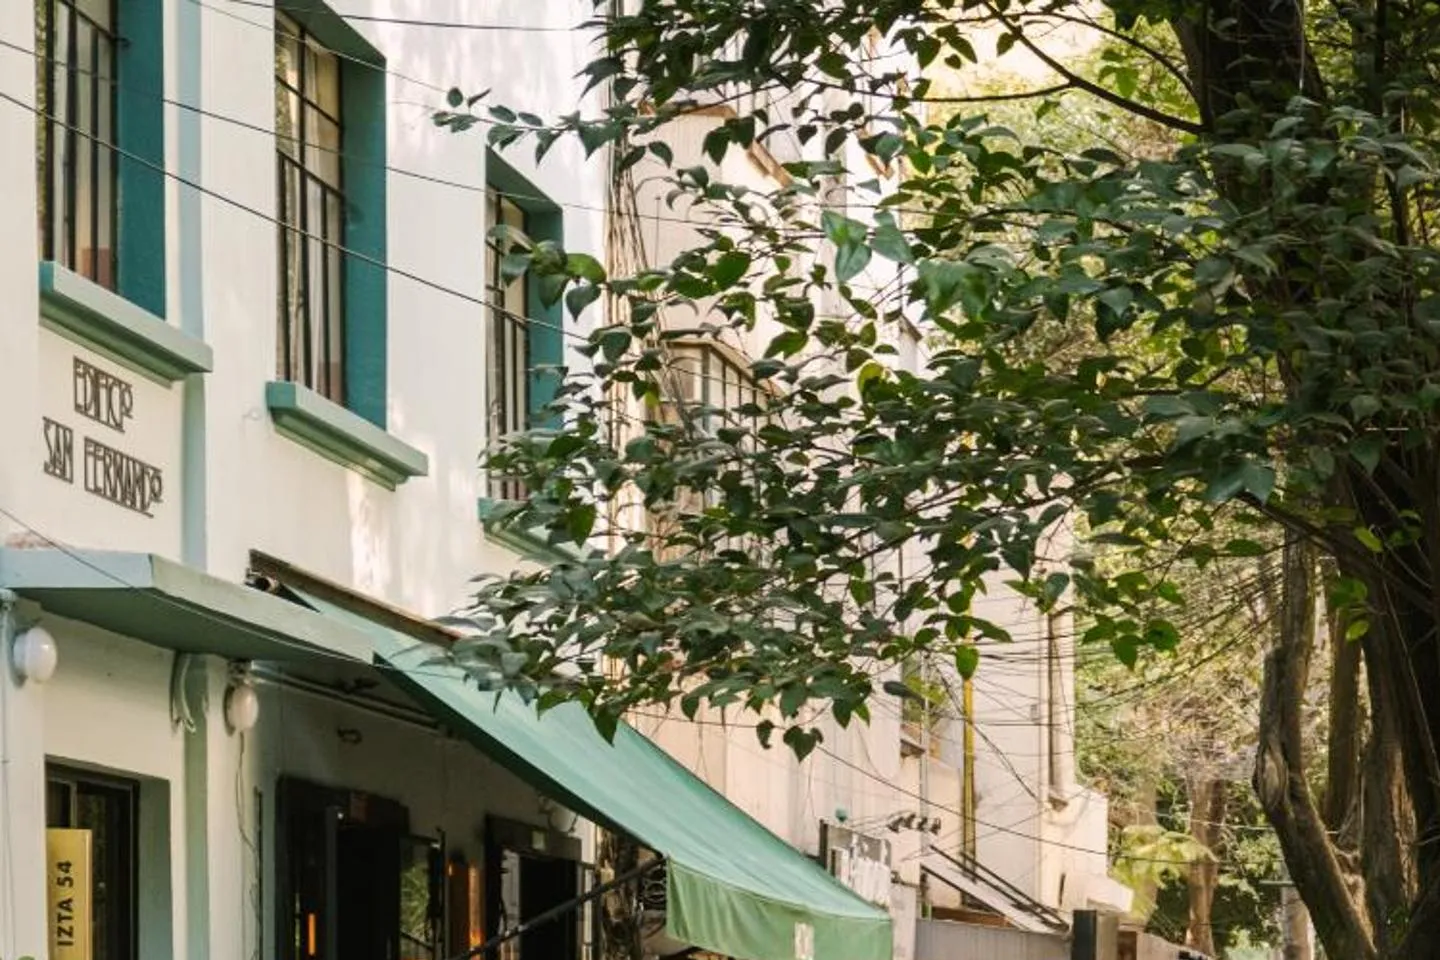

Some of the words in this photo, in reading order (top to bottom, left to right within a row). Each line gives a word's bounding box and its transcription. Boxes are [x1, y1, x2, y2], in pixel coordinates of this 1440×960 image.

[73, 355, 133, 432] EDIFICIO
[42, 416, 73, 484] SAN
[84, 437, 162, 518] FERNANDO
[56, 860, 74, 888] 54
[57, 898, 74, 946] IZTA
